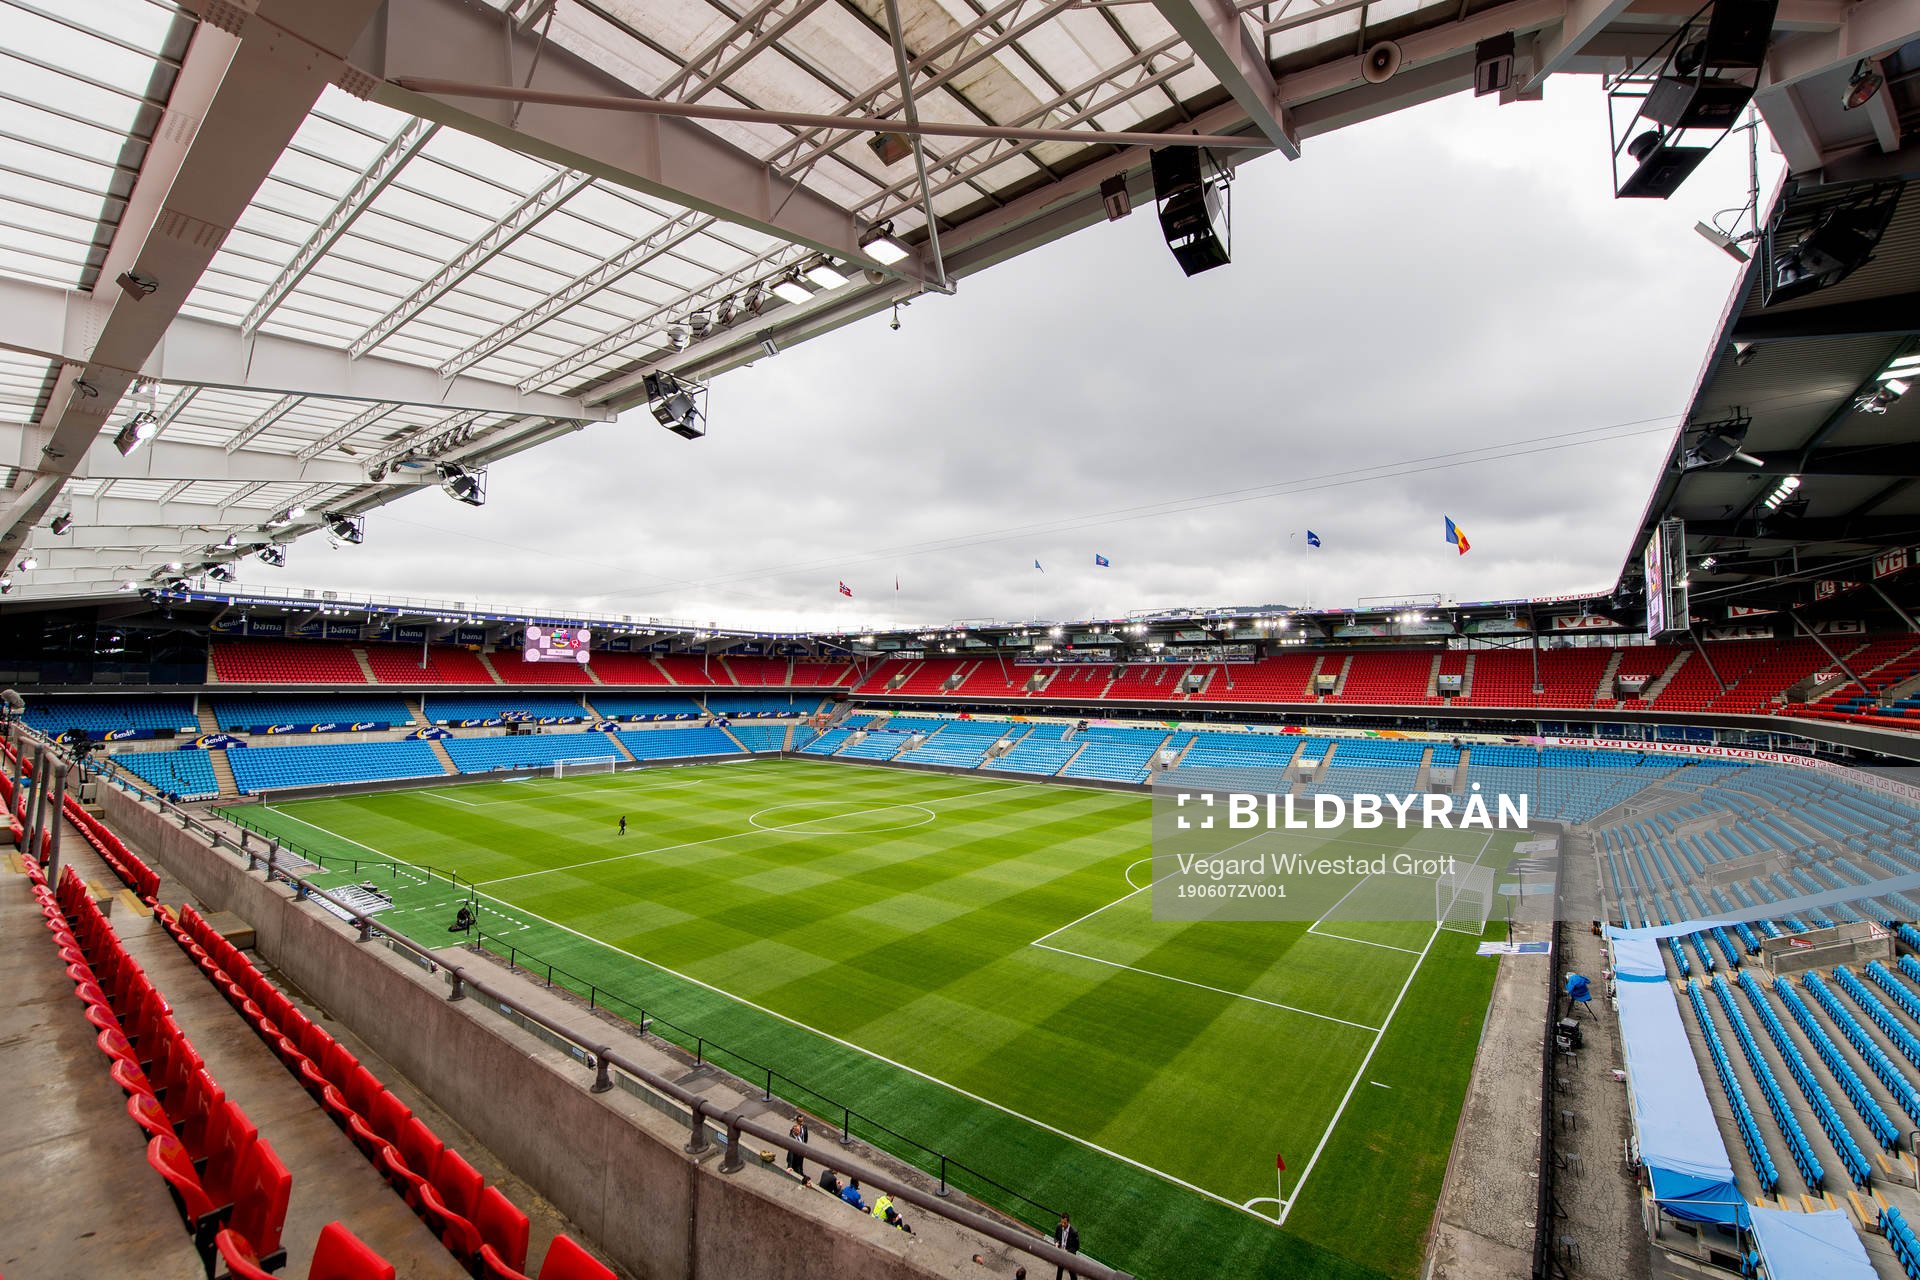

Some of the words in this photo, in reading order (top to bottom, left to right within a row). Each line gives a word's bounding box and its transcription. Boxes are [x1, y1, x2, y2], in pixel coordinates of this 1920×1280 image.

[252, 621, 282, 631] bama
[1560, 616, 1612, 628] VG
[330, 625, 357, 635] bama
[399, 629, 423, 638] bama
[461, 632, 482, 641] bama
[275, 724, 295, 733] Bendit
[113, 728, 136, 739] Bendit
[204, 735, 228, 745] Bendit
[1558, 738, 1588, 746] VG
[1661, 744, 1691, 752] VG
[1695, 746, 1723, 755] VG
[1727, 749, 1754, 758] VG
[1757, 752, 1779, 761] VG
[1802, 758, 1816, 767] VG
[1876, 777, 1889, 790] VG
[1891, 782, 1906, 796] VG
